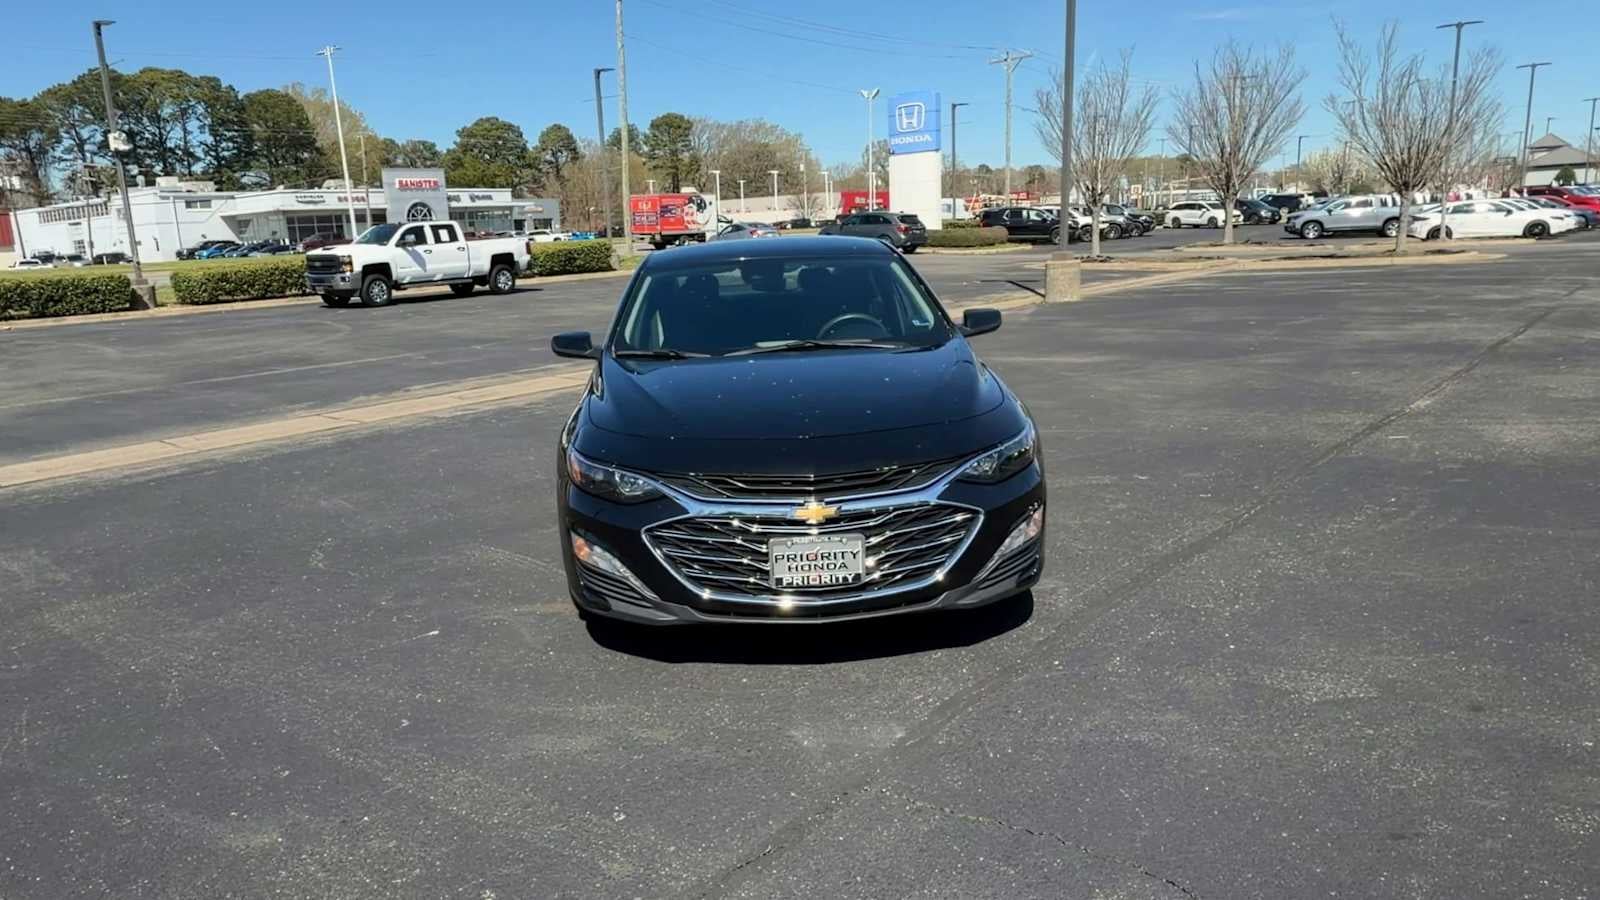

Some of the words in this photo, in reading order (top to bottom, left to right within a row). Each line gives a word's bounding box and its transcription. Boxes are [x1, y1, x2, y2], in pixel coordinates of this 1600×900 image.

[890, 135, 933, 145] HONDA
[775, 550, 860, 563] PRIORITY
[788, 562, 848, 572] HONDA
[783, 573, 855, 586] PRIORITY
